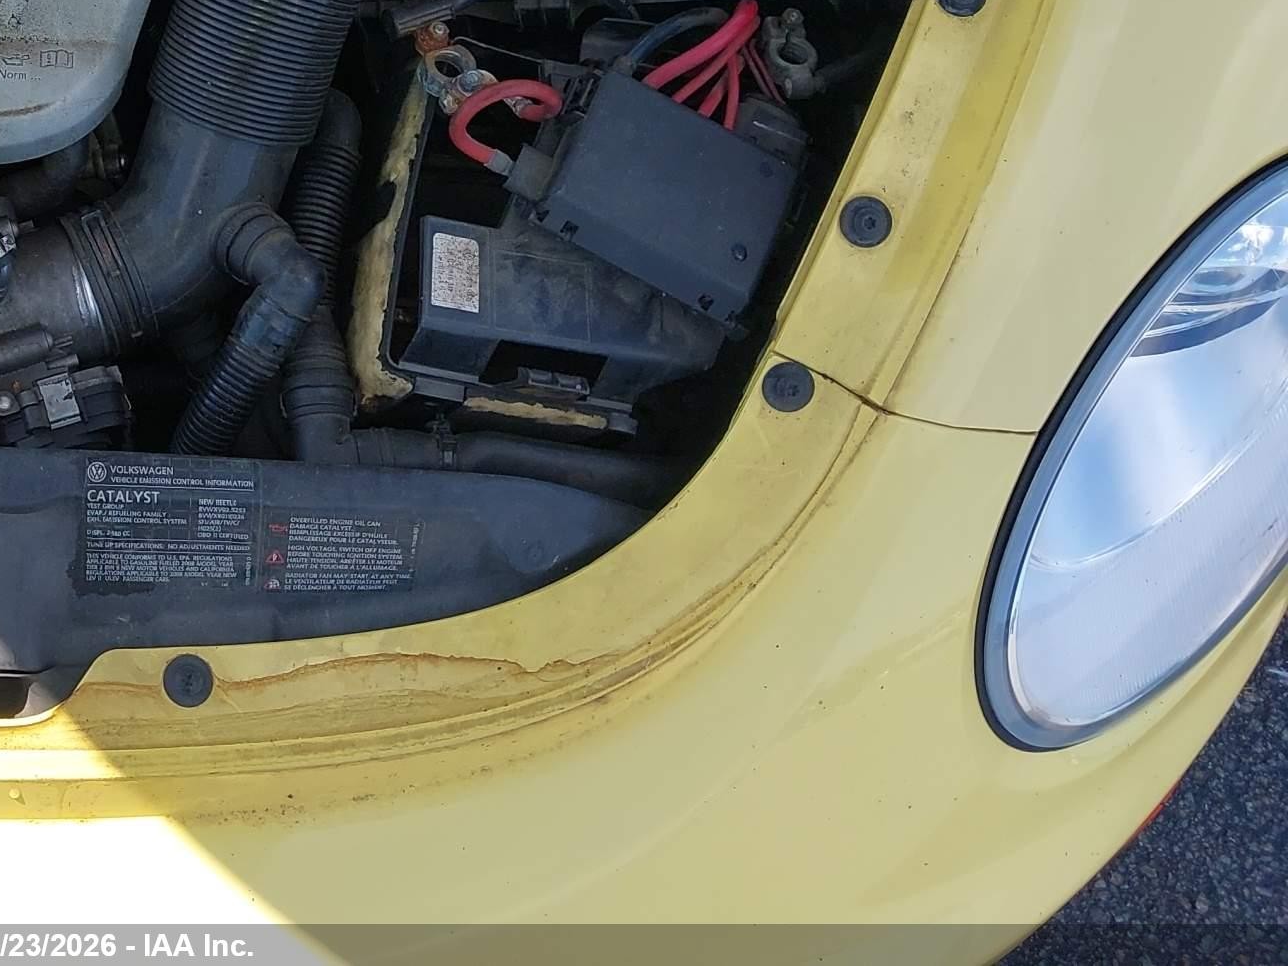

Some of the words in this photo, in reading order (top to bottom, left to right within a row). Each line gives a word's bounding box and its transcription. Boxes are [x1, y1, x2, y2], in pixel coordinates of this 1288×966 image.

[110, 465, 174, 475] VOLKSWAGEN
[110, 476, 138, 484] VEHICLE
[139, 477, 172, 485] EMISSION
[172, 478, 204, 486] CONTROL
[205, 479, 254, 487] INFORMATION
[87, 489, 161, 504] CATALYST
[199, 498, 214, 506] NEW
[179, 543, 224, 551] ADJUSTMENTS
